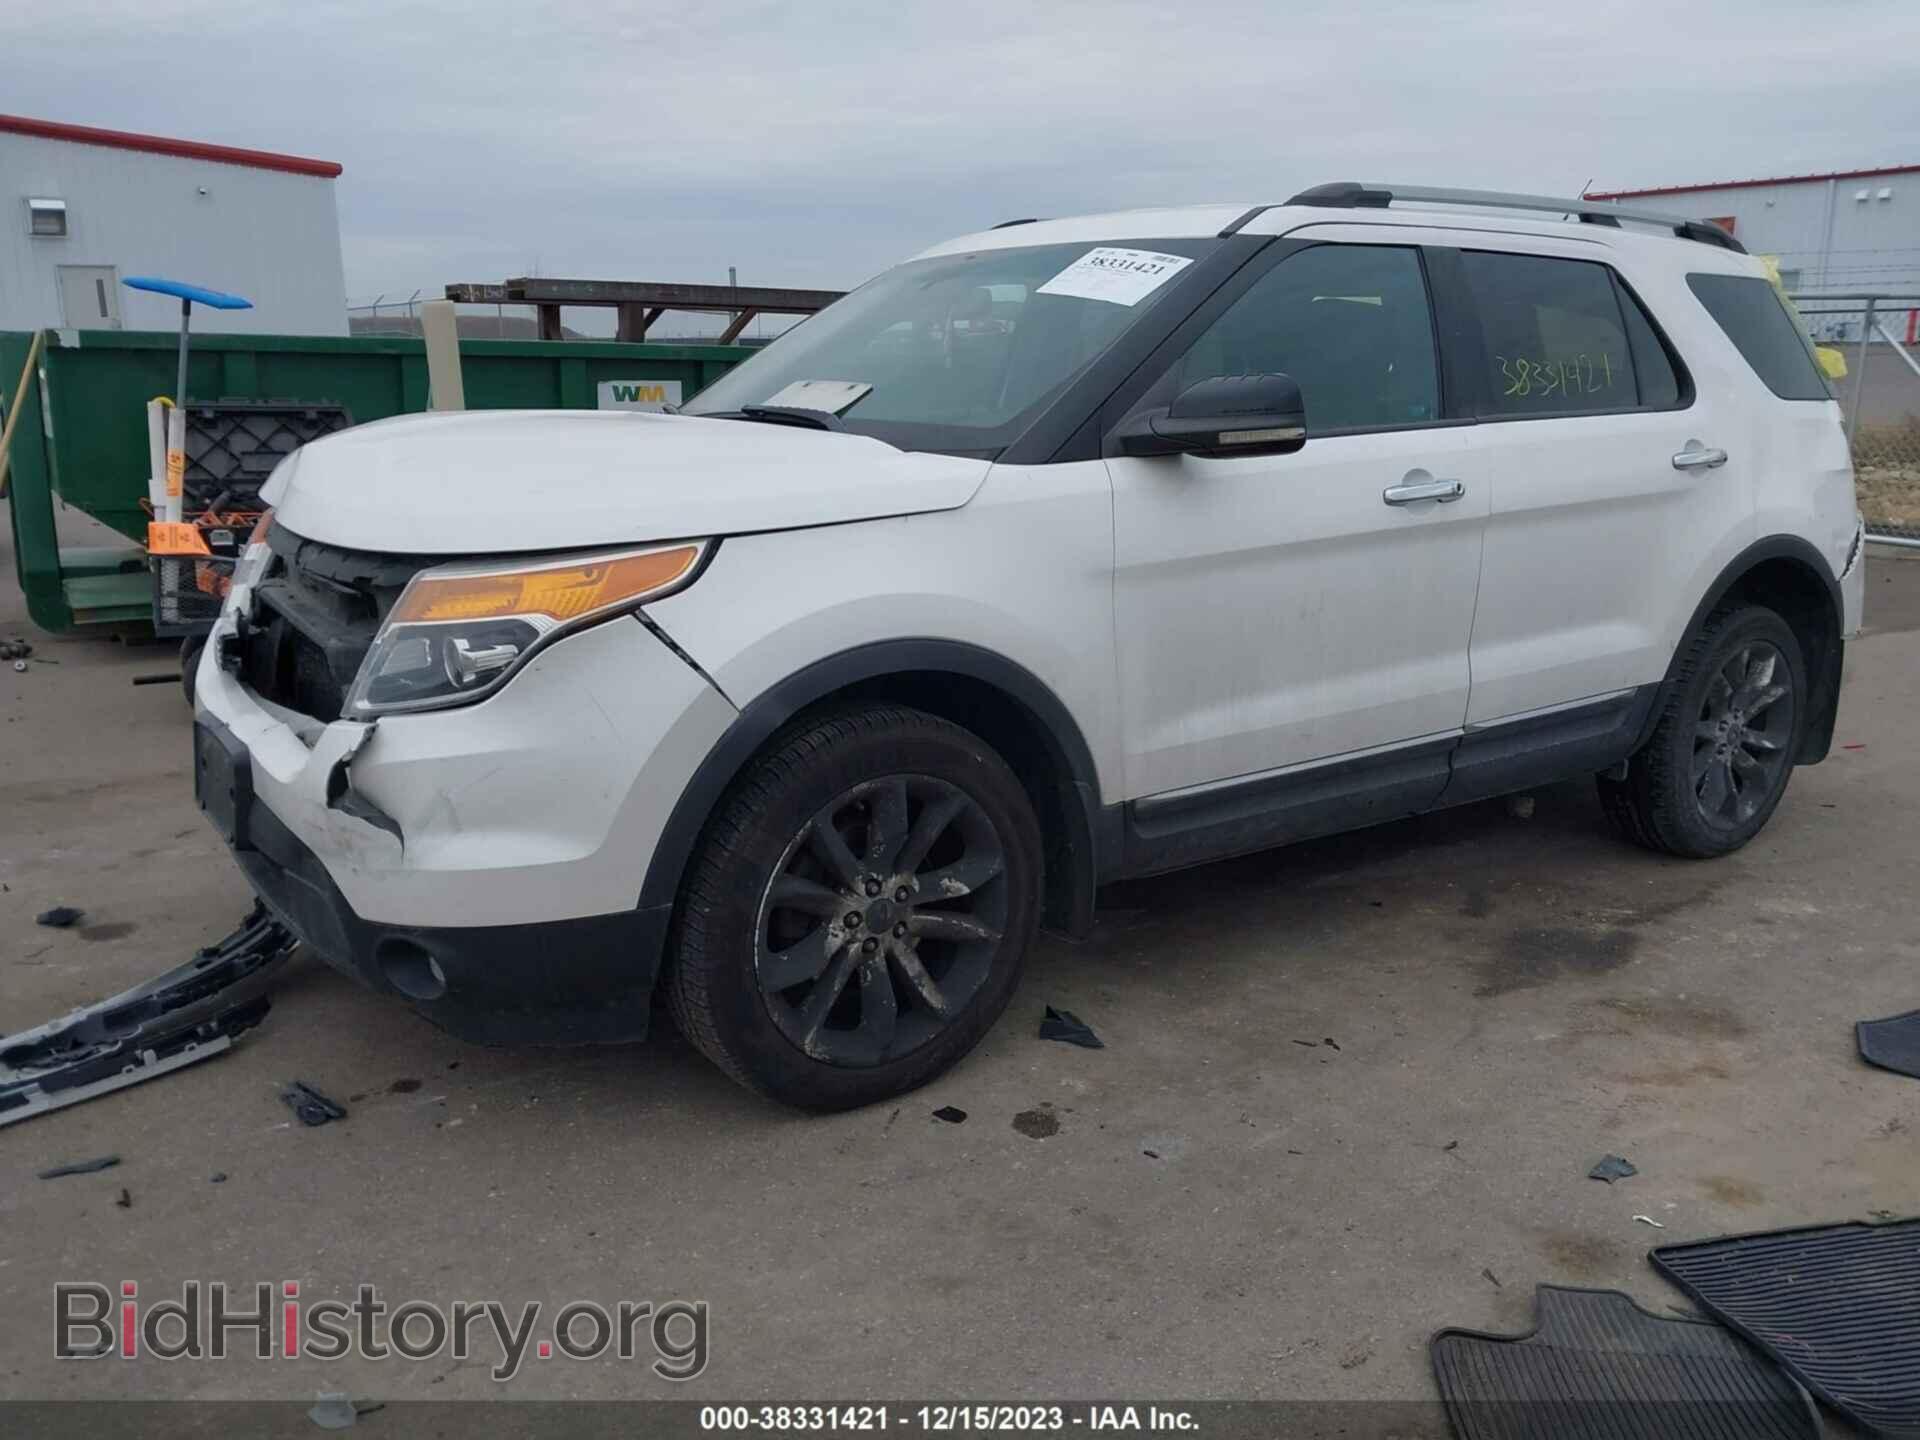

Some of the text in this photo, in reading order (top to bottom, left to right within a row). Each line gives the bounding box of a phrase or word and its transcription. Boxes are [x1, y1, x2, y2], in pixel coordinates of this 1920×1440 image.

[1089, 256, 1166, 275] 38331421
[1496, 353, 1612, 397] 38331421
[612, 384, 666, 403] WM
